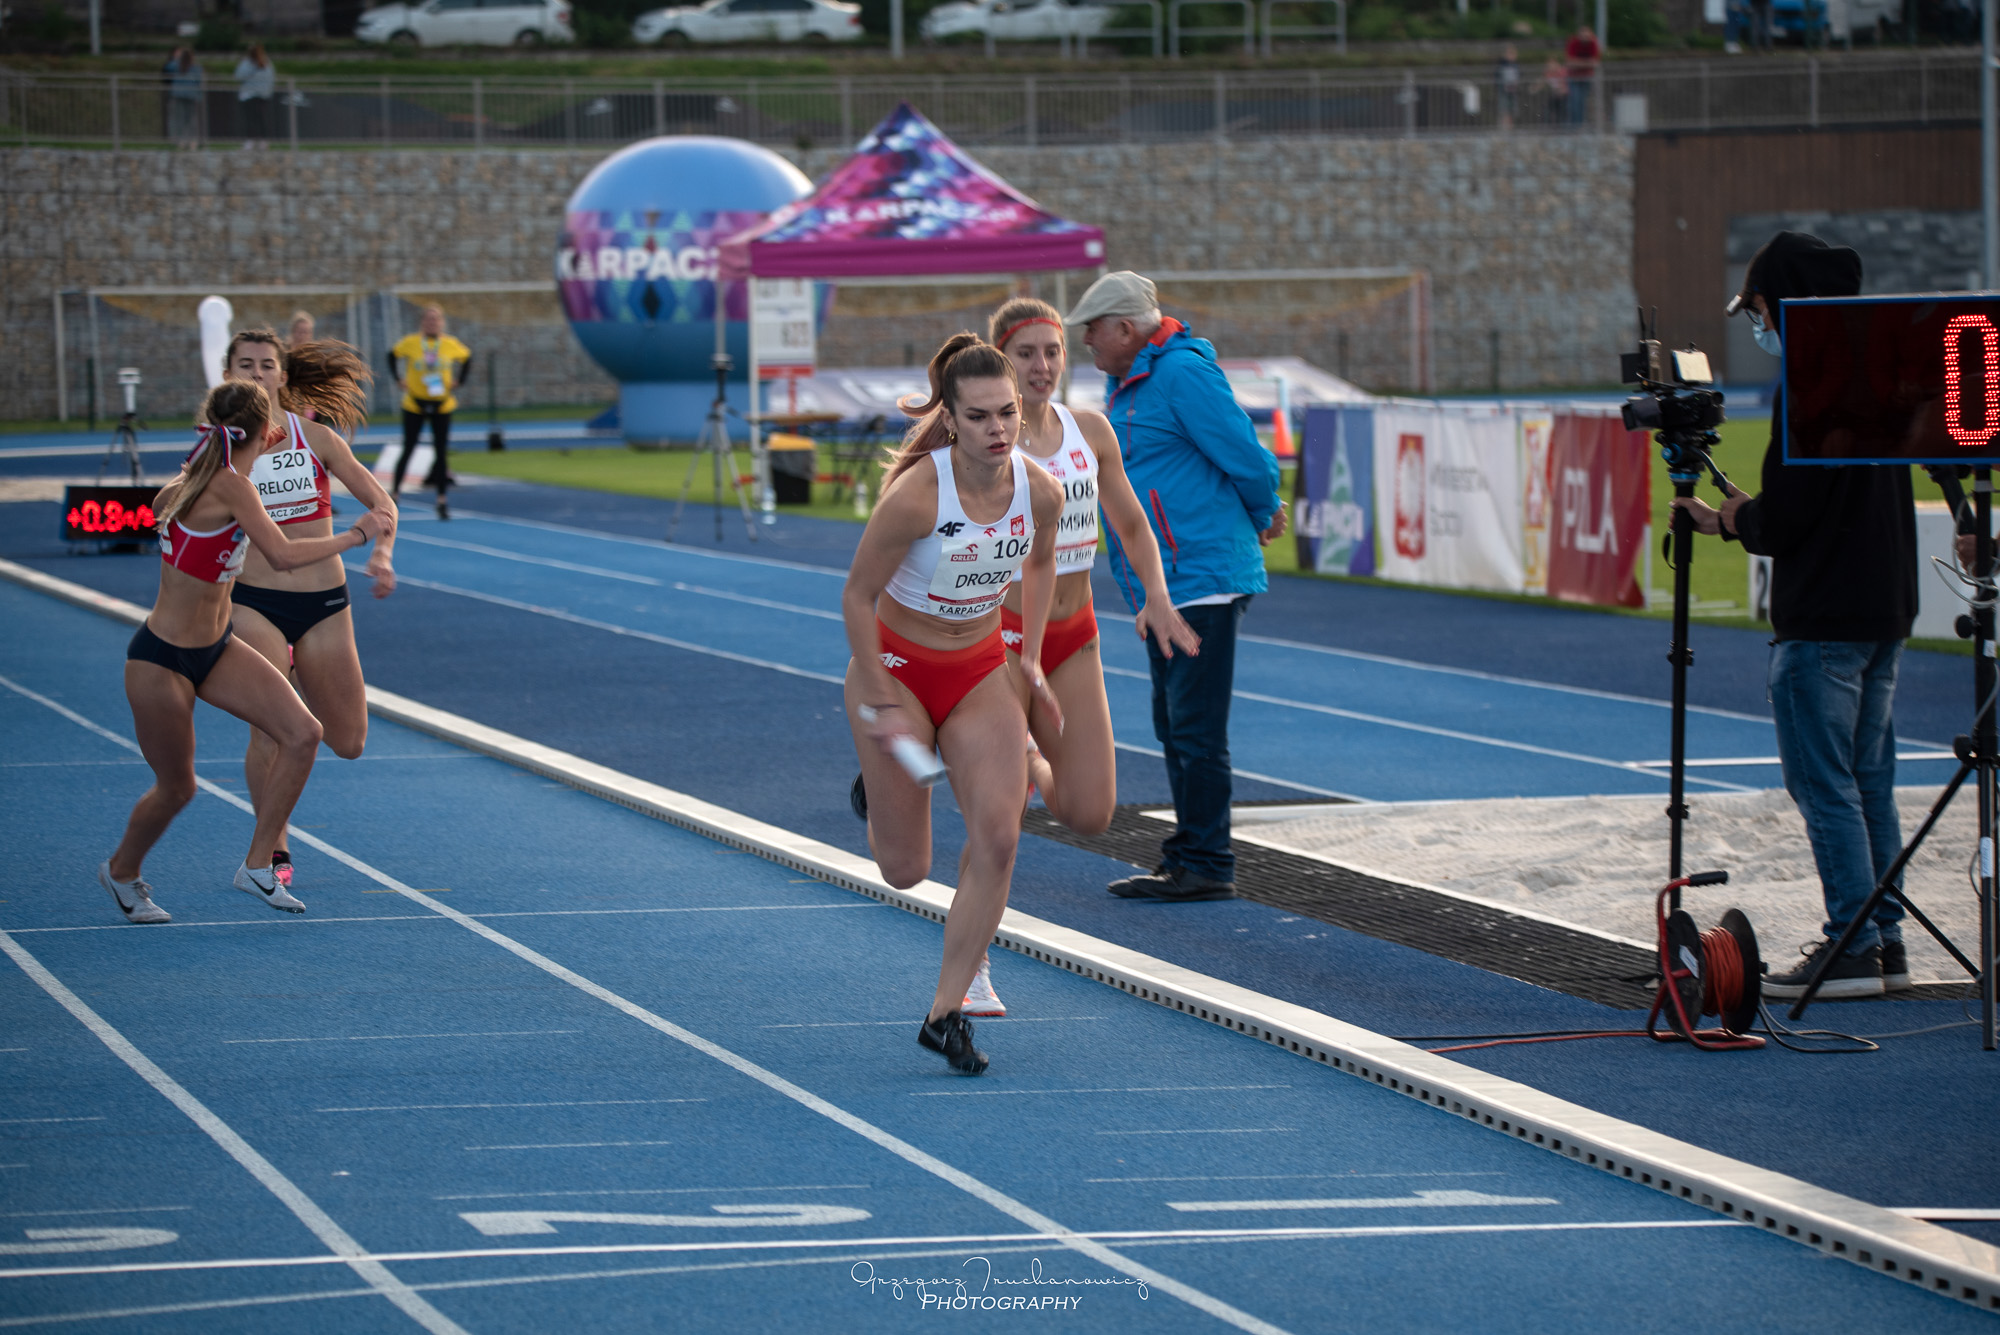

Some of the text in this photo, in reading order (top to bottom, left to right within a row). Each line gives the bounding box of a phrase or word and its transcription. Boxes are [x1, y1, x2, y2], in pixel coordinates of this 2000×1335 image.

[1943, 314, 2000, 446] 0
[272, 452, 305, 470] 520
[937, 521, 966, 537] 4F
[993, 537, 1030, 560] 106
[955, 570, 1012, 589] DROZD
[938, 603, 986, 615] KARPACZ
